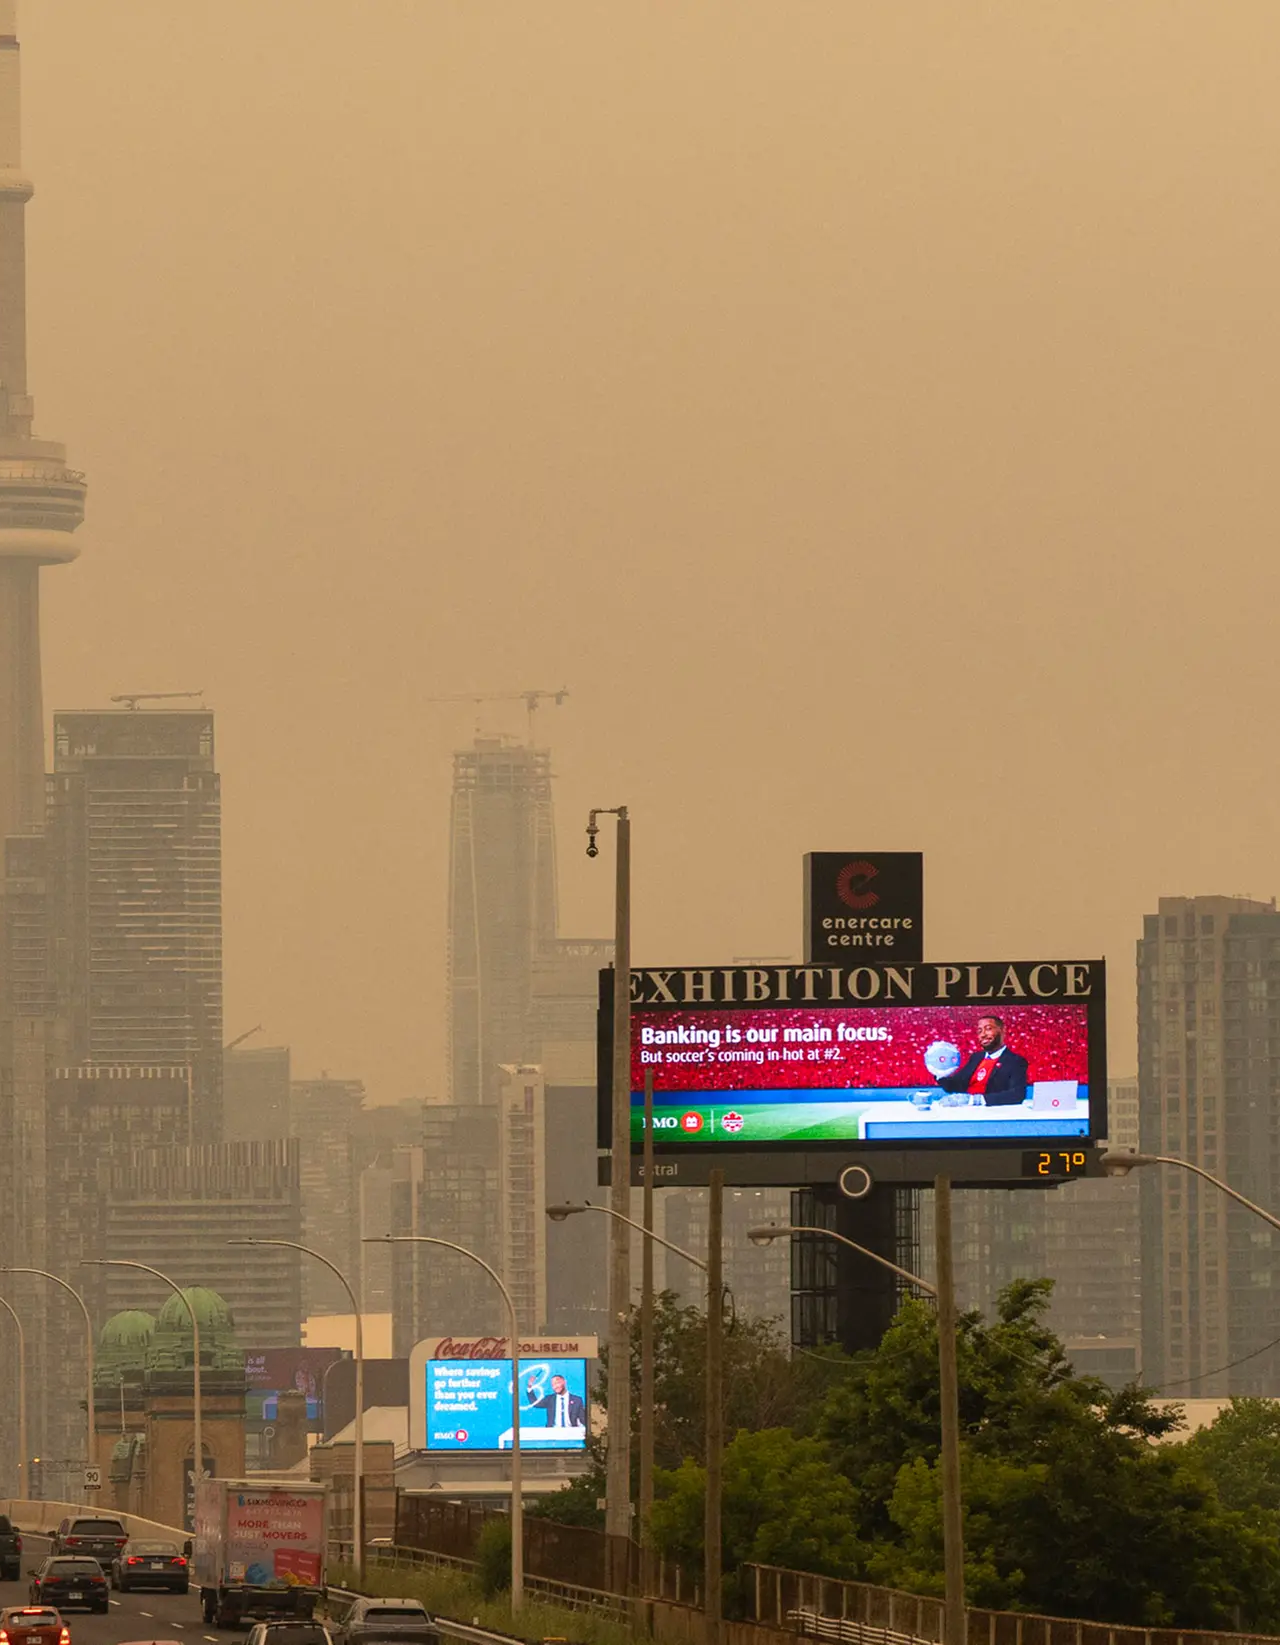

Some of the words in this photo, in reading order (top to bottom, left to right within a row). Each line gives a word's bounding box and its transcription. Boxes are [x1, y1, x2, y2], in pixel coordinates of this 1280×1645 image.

[822, 917, 913, 929] enercare
[827, 932, 895, 946] centre
[935, 964, 1093, 999] PLACE
[641, 1025, 720, 1048] Banking
[725, 1025, 741, 1042] is
[747, 1029, 778, 1042] our
[783, 1024, 832, 1042] main
[837, 1023, 893, 1042] focus,
[641, 1050, 662, 1063] But
[718, 1050, 764, 1064] coming
[767, 1049, 779, 1061] in
[783, 1048, 803, 1061] hot
[807, 1049, 820, 1061] at
[824, 1048, 845, 1060] #2.
[638, 1163, 678, 1176] atral
[434, 1367, 463, 1377] Where
[465, 1367, 501, 1379] savings
[434, 1380, 446, 1391] go
[448, 1379, 481, 1389] further
[434, 1391, 455, 1400] than
[458, 1392, 474, 1401] you
[477, 1392, 498, 1400] ever
[434, 1402, 478, 1412] dreamed.
[86, 1471, 98, 1482] 90
[238, 1520, 270, 1529] MORE
[272, 1521, 301, 1530] THAN
[262, 1531, 308, 1541] MOVERS
